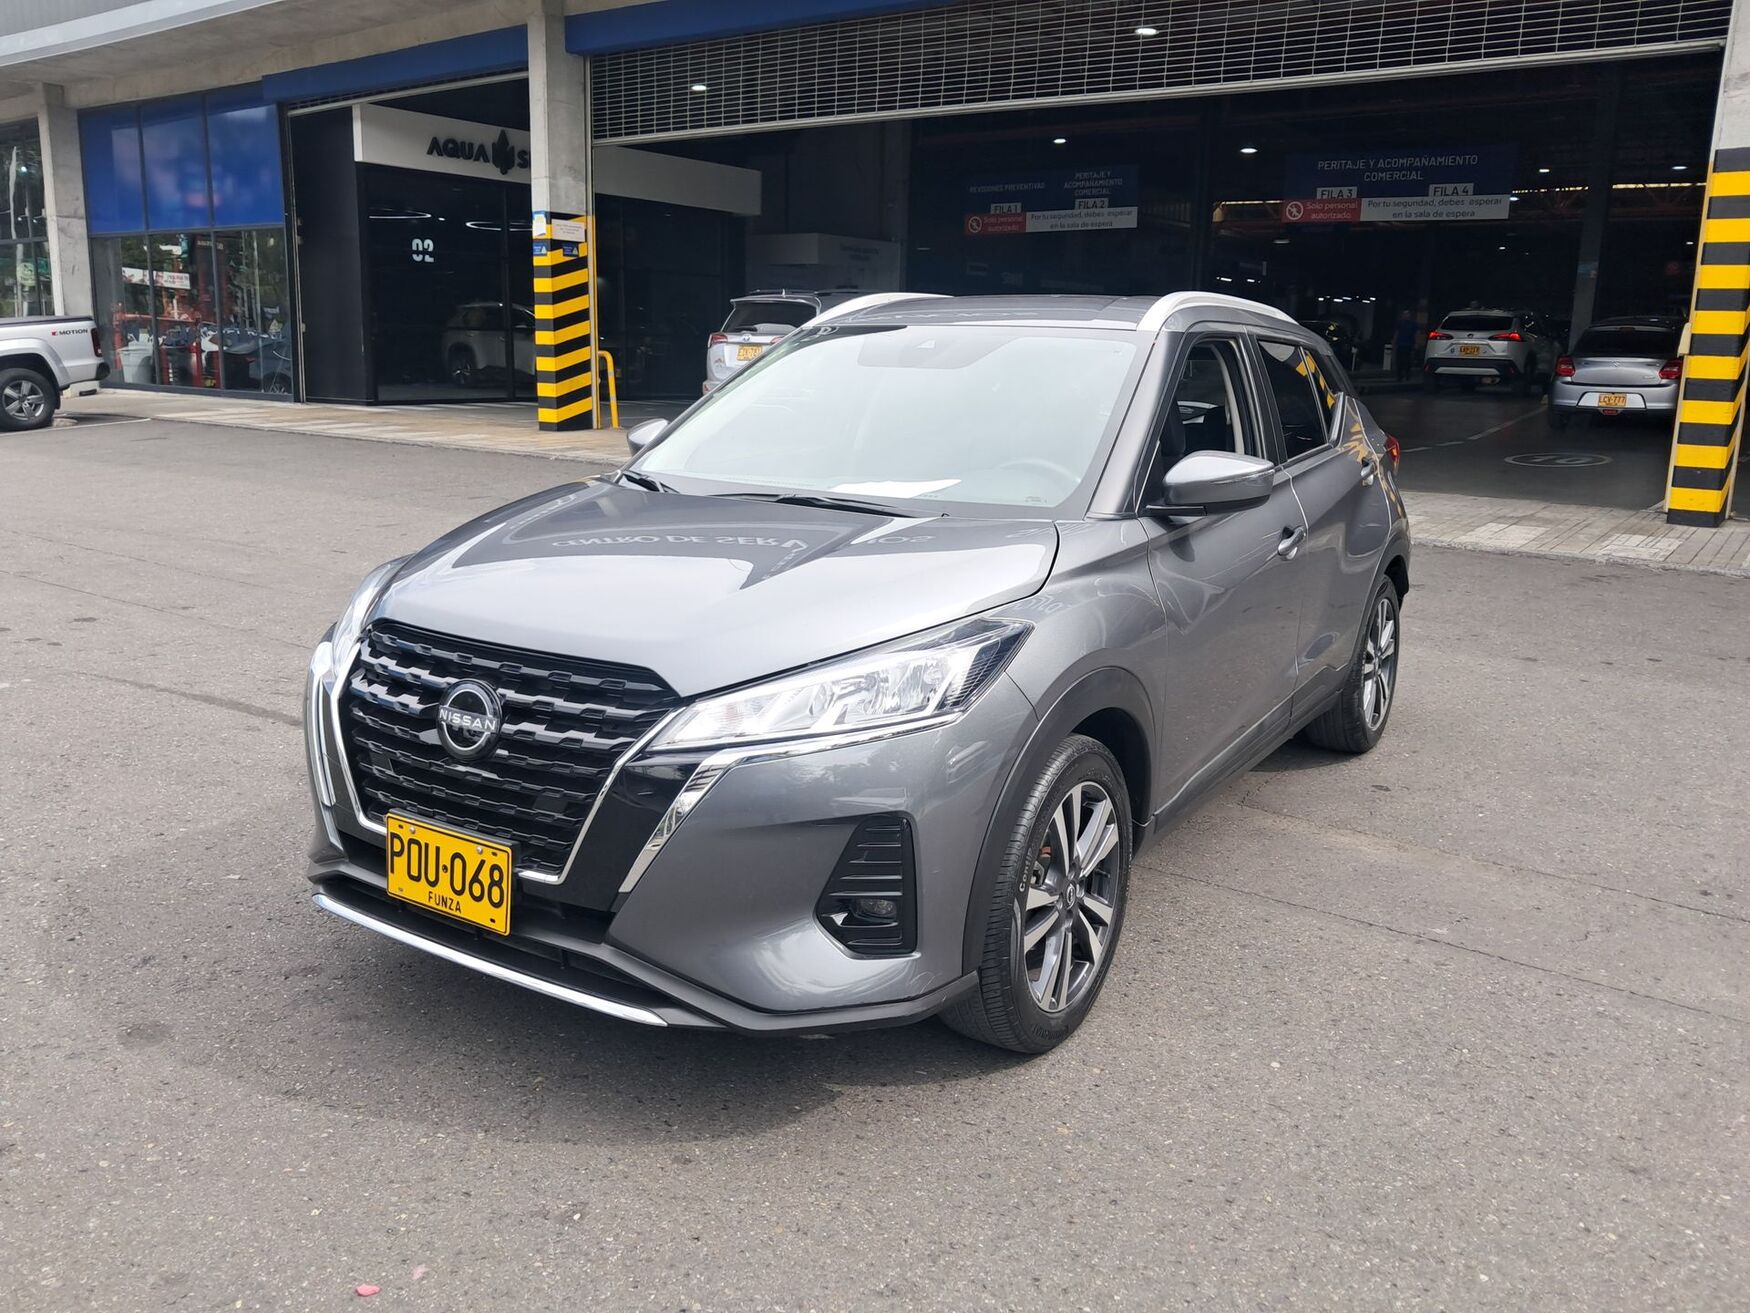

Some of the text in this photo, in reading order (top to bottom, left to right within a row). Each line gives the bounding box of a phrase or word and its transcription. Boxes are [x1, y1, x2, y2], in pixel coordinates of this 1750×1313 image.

[426, 136, 530, 169] AQUA S
[1318, 154, 1478, 170] PERITAJE Y ACOMPAÑAMIENTO
[1363, 171, 1424, 182] COMERCIAL
[1321, 188, 1353, 199] FILA 3
[1433, 186, 1469, 197] FILA 4
[1078, 200, 1098, 209] FILA
[1306, 201, 1358, 211] Solo personal
[1368, 199, 1380, 208] Por
[1382, 199, 1391, 207] tu
[1438, 197, 1465, 206] debes
[993, 204, 1015, 214] FILA
[1392, 211, 1403, 219] en
[1414, 210, 1431, 218] sala
[1432, 209, 1444, 218] de
[1445, 210, 1475, 220] espera
[1311, 211, 1351, 220] autorizado
[411, 237, 435, 263] 02
[439, 709, 496, 731] NISSAN
[427, 890, 462, 914] FUNZA
